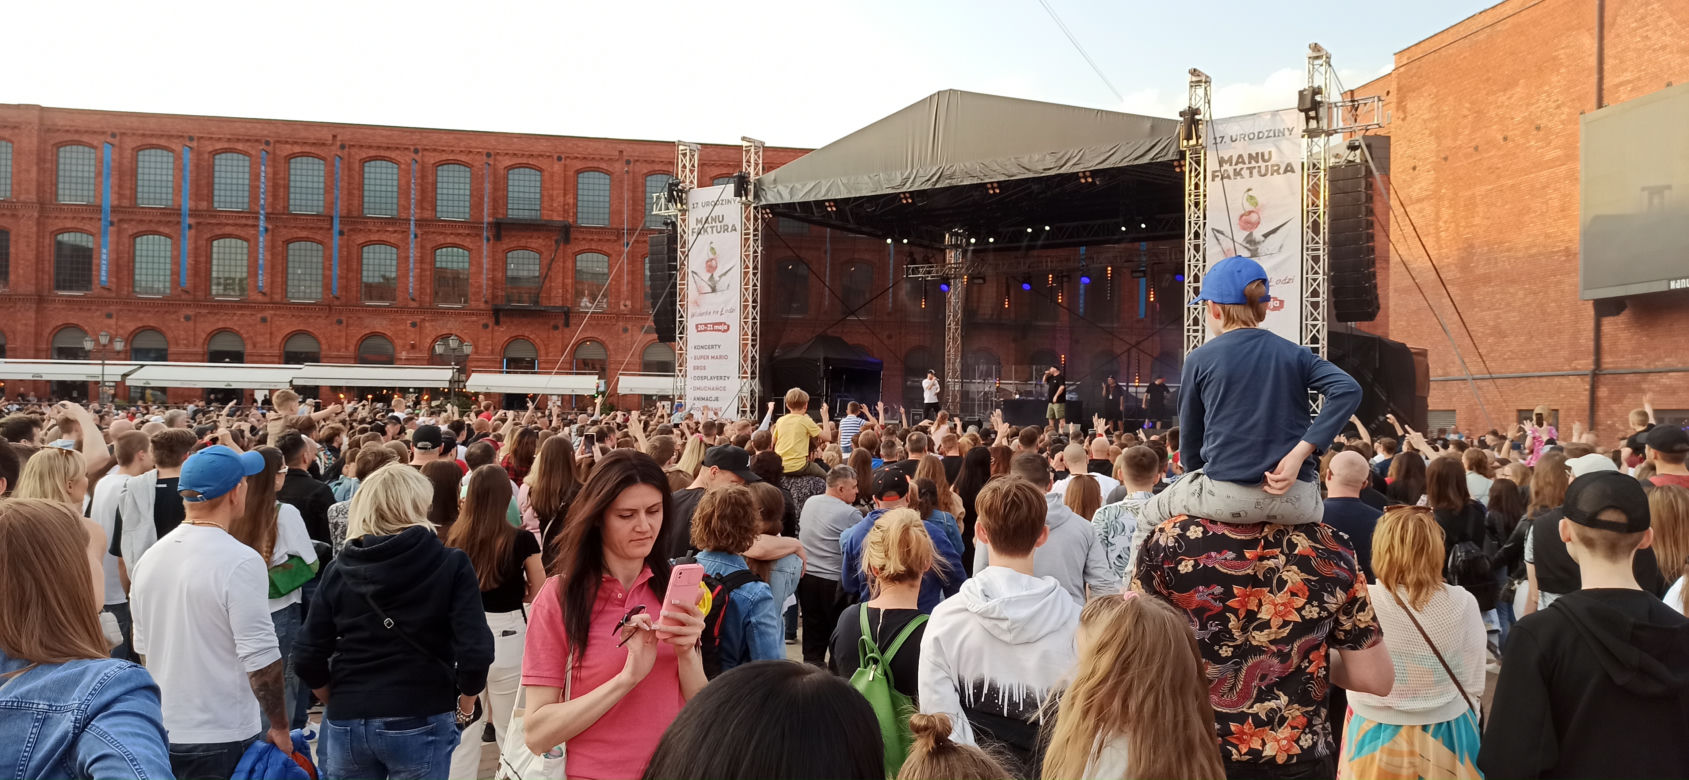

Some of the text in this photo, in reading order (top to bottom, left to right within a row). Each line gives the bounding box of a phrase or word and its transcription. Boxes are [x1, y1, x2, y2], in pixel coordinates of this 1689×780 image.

[1230, 126, 1295, 142] URODZINY
[1219, 150, 1272, 168] MANU
[1211, 162, 1296, 182] FAKTURA
[701, 199, 737, 208] URODZINY
[696, 214, 724, 226] MANU
[691, 224, 737, 236] FAKTURA
